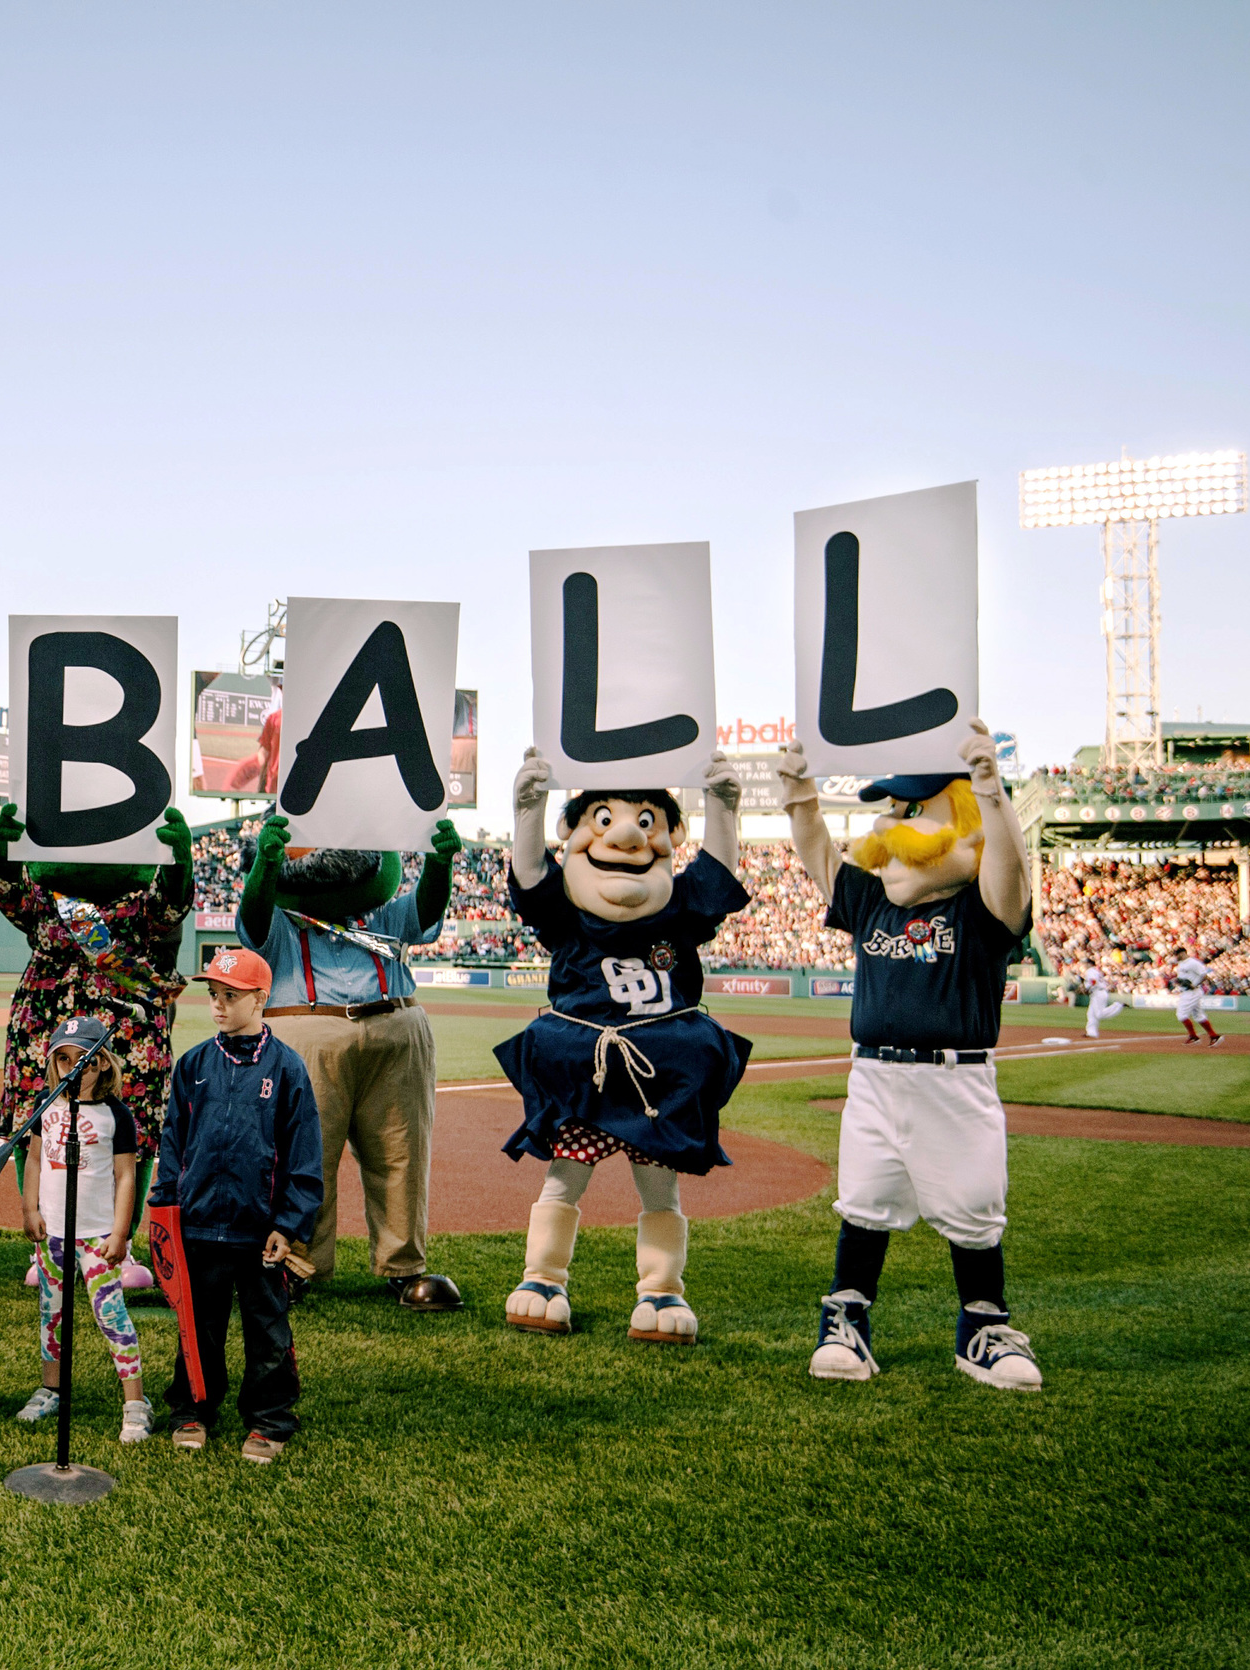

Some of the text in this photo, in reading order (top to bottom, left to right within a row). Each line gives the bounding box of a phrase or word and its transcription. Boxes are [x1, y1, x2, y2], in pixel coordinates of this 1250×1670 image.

[819, 531, 958, 747] L
[561, 571, 699, 763] L
[280, 620, 445, 816] A
[26, 632, 172, 847] B
[756, 761, 768, 770] TO
[746, 771, 772, 781] PARK
[751, 787, 770, 797] THE
[760, 799, 778, 808] SOX
[722, 978, 770, 994] xfinity
[65, 1019, 79, 1035] B
[259, 1078, 273, 1099] B
